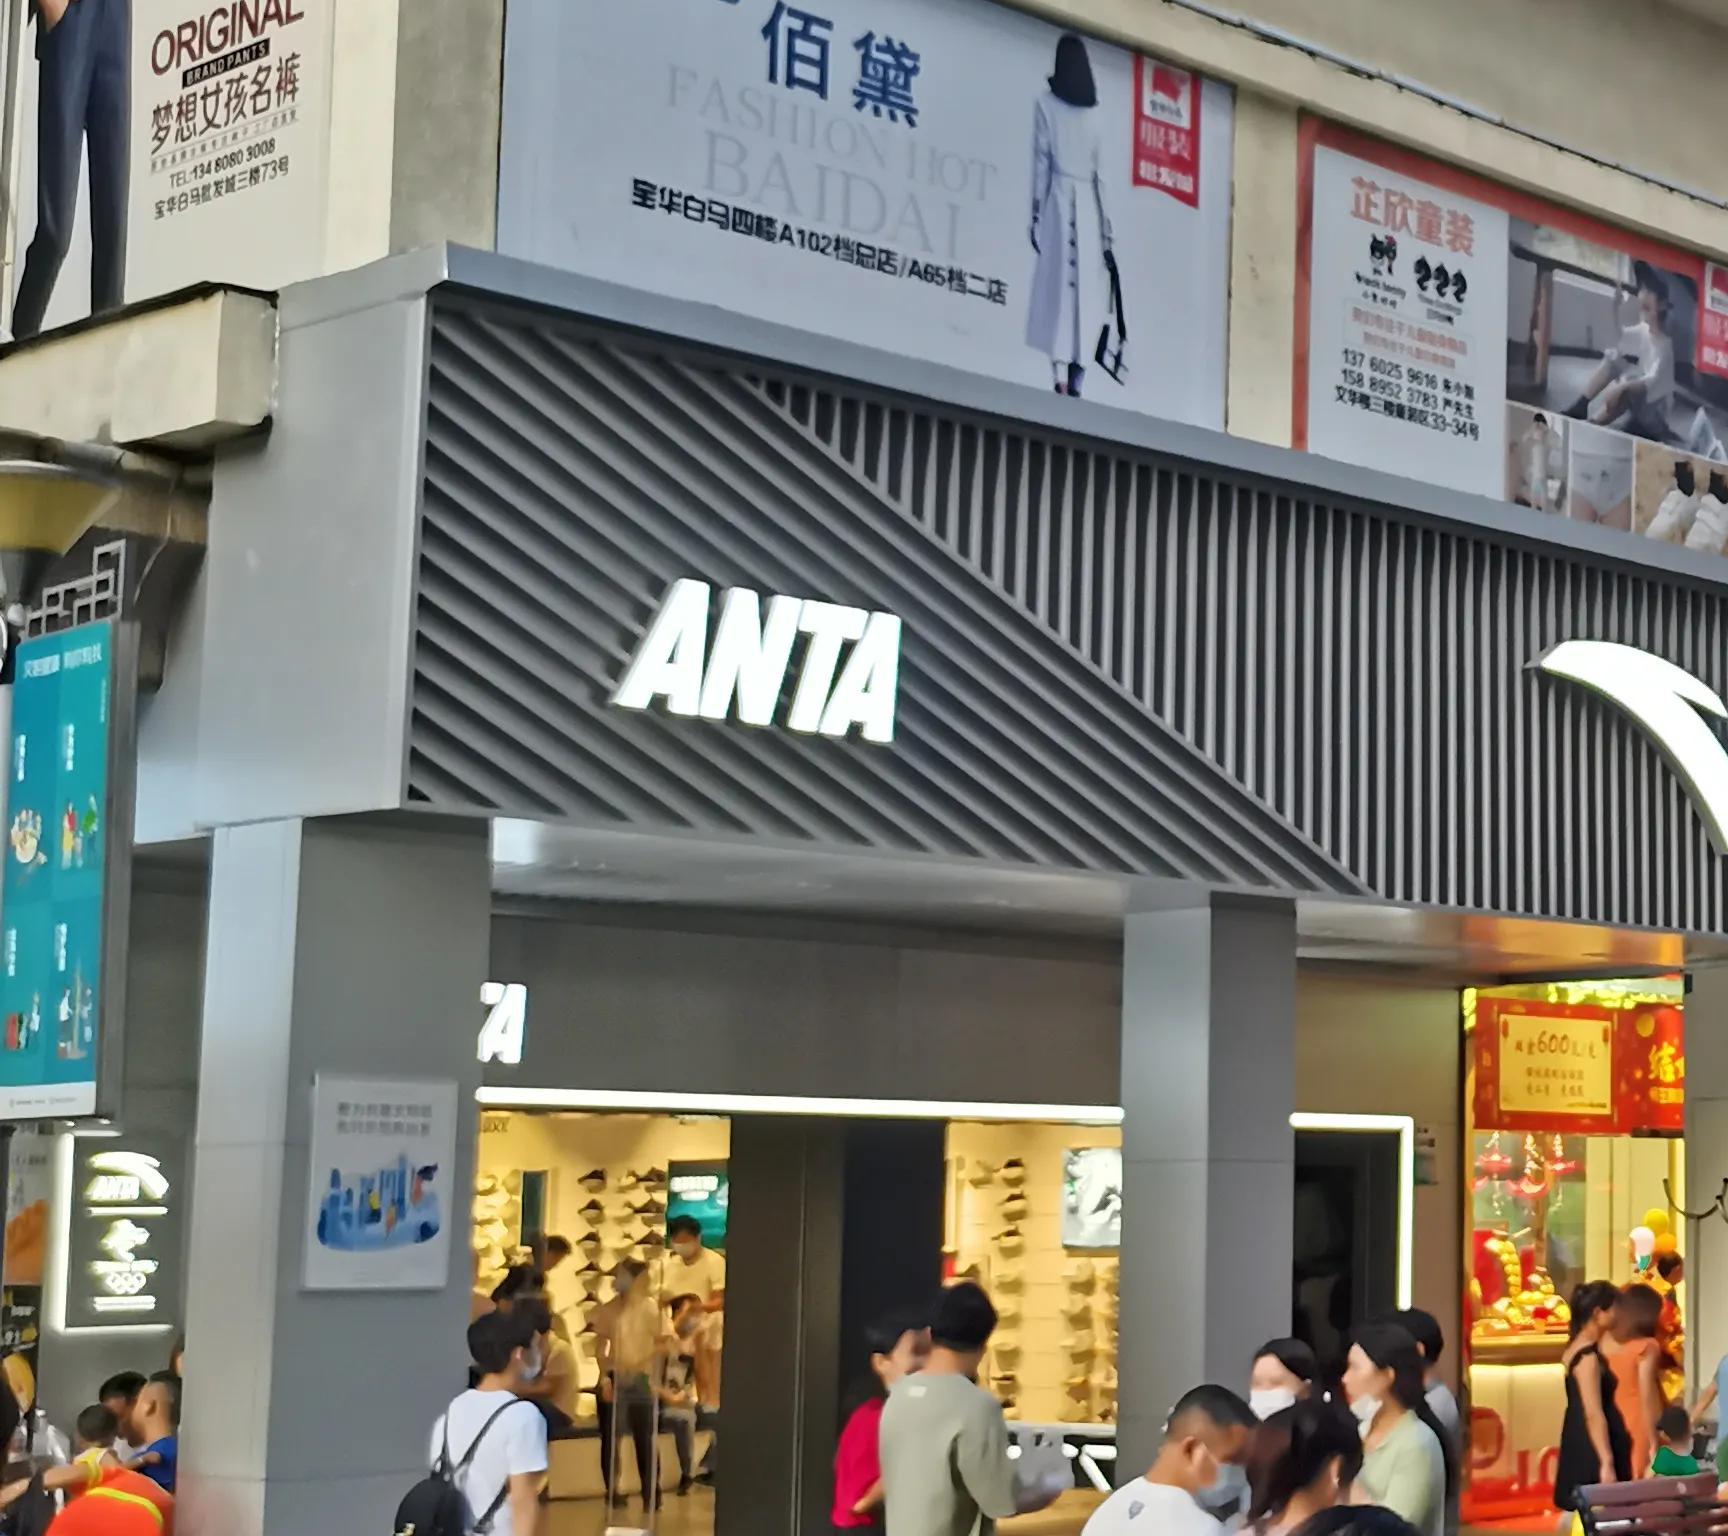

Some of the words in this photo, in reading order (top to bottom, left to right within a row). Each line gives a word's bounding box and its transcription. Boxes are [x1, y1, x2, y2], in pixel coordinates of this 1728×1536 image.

[150, 51, 302, 156] 梦想女孩名裤
[186, 58, 224, 86] BRAND
[226, 42, 266, 70] PANTS
[666, 62, 889, 169] FASHION
[214, 148, 244, 174] 8080
[246, 136, 276, 163] 3008
[701, 126, 963, 261] BAIDAI
[610, 577, 902, 744] ANTA
[476, 981, 528, 1064] A
